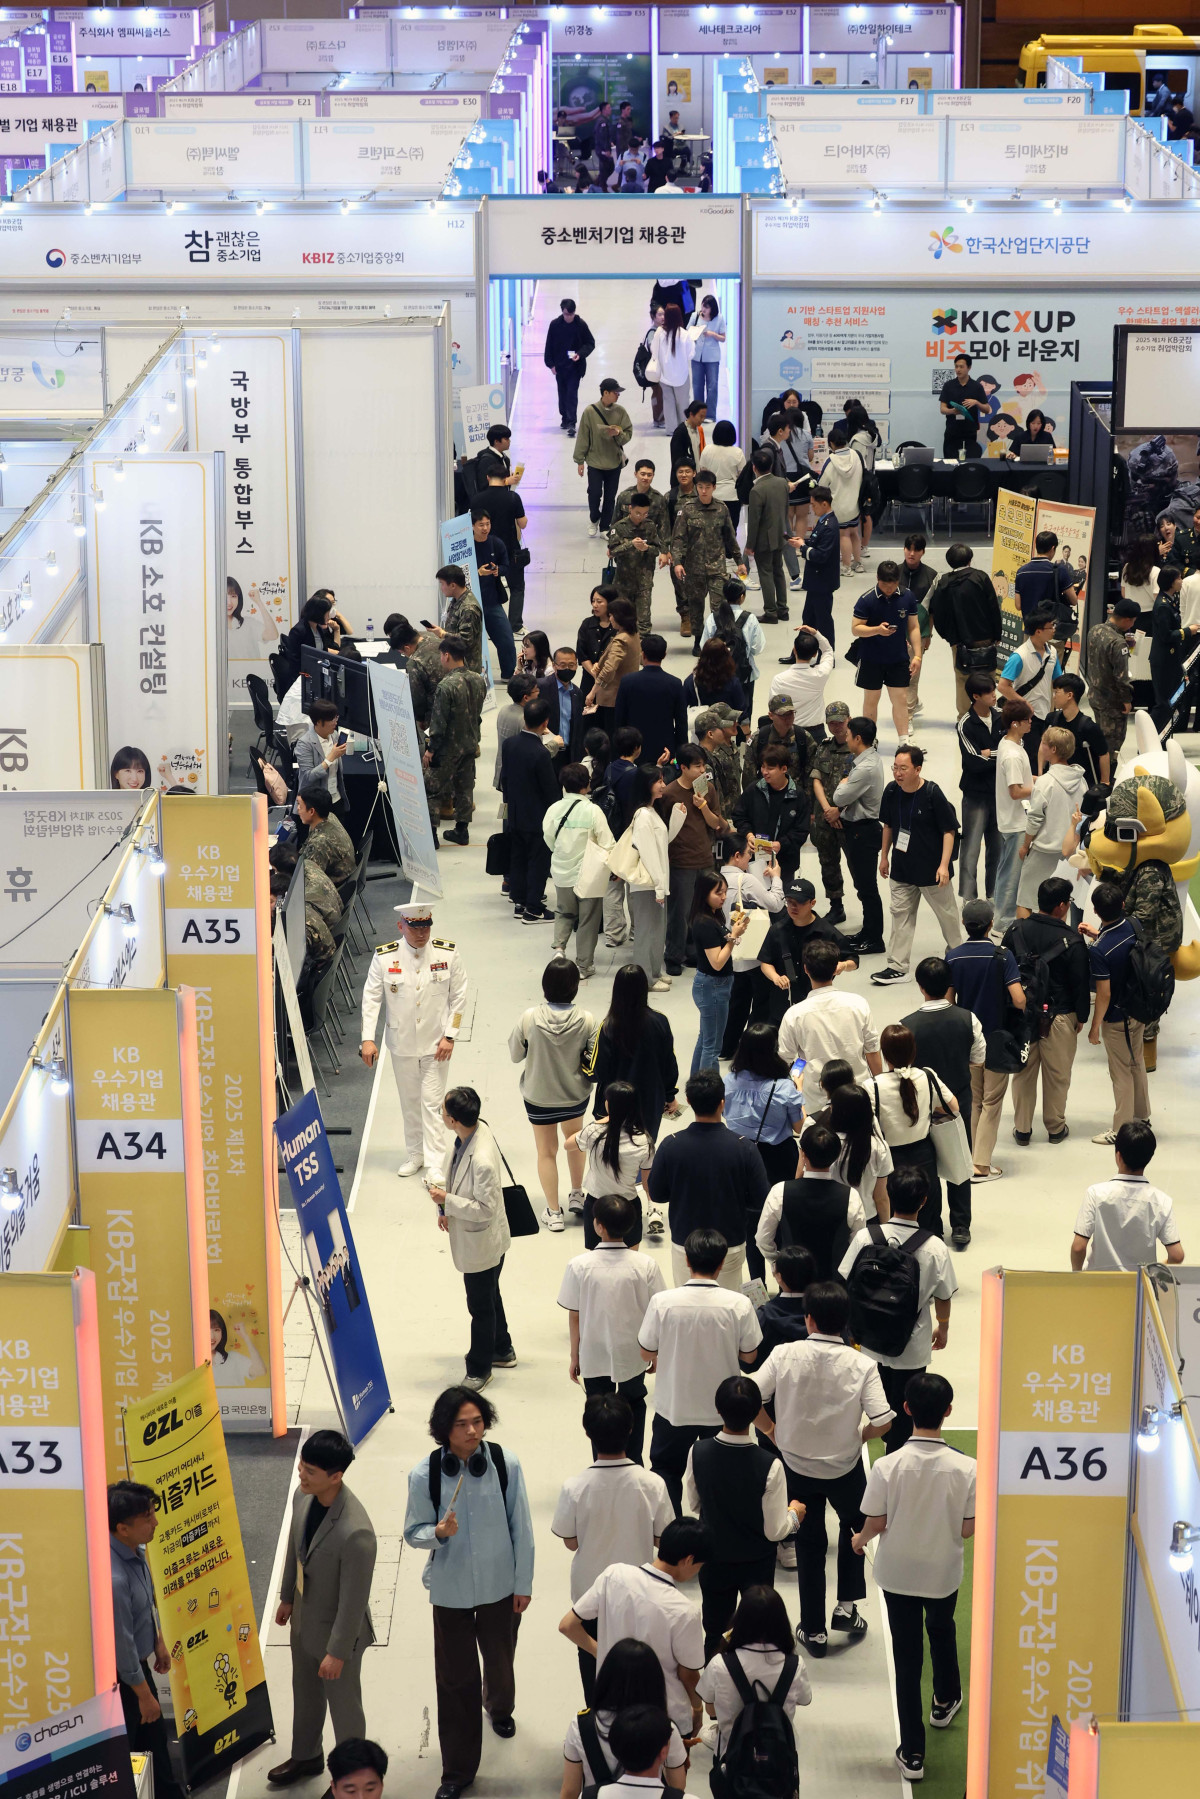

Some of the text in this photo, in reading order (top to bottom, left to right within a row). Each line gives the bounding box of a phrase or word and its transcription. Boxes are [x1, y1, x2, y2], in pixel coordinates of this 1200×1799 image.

[79, 27, 171, 38] 주식회사 엠피씨플러스
[698, 24, 761, 35] 세나테크코리아
[27, 69, 42, 77] E17
[1, 84, 17, 92] E18
[297, 98, 311, 106] E21
[463, 98, 476, 106] E30
[1067, 96, 1081, 104] F20
[15, 118, 38, 132] 기업
[42, 118, 78, 132] 채용관
[448, 220, 465, 229] H12
[541, 226, 687, 246] 중소벤처기업 채용관
[966, 237, 1090, 254] 한국산업단지공단
[184, 230, 260, 263] 참 괜찮은
[216, 249, 261, 262] 중소기업
[70, 253, 142, 265] 중소벤처기업부
[337, 252, 404, 264] 중소기업중앙회
[800, 306, 816, 316] 기반
[818, 306, 851, 315] 스타트업
[853, 306, 885, 316] 지원사업
[1118, 307, 1134, 315] 우수
[845, 318, 868, 327] 서비스
[961, 310, 1076, 333] KICXUP
[1157, 344, 1192, 352] 취업박람회
[1167, 336, 1192, 344] KB굿잡
[926, 339, 1080, 362] 비즈모아 라운지
[230, 371, 251, 444] 국방부
[468, 422, 490, 433] 중소기업
[232, 458, 255, 554] 통합부스
[140, 519, 168, 695] KB 소호 컨설팅
[0, 728, 29, 772] KB
[197, 846, 220, 859] KB
[179, 865, 240, 882] 우수기업
[187, 885, 233, 902] 채용관
[182, 919, 241, 944] A35
[113, 1046, 140, 1063] KB
[92, 1069, 163, 1089] 우수기업
[101, 1093, 156, 1113] 채용관
[224, 1074, 246, 1176] 2025 제1차
[96, 1132, 167, 1160] A34
[280, 1119, 321, 1162] Human
[294, 1151, 319, 1187] TSS
[105, 1209, 139, 1305] KB굿잡
[150, 1309, 172, 1364] 2025
[0, 1340, 30, 1360] KB
[113, 1307, 139, 1387] 우수기업
[1052, 1344, 1085, 1366] KB
[1022, 1372, 1111, 1396] 우수기업
[184, 1403, 202, 1421] 이즐
[219, 1406, 267, 1415] B 국민은행
[1032, 1400, 1100, 1424] 채용관
[1020, 1446, 1109, 1480] A36
[156, 1466, 180, 1484] 여기저기
[154, 1464, 217, 1516] 이즐카드
[159, 1500, 220, 1543] 교통카드 캐시비로부터
[163, 1539, 181, 1555] 지금의
[164, 1535, 224, 1576] 이즐크루는 새로운
[163, 1549, 232, 1595] 미래를 만들어갑니다.
[1019, 1539, 1059, 1653] KB굿잡
[44, 1651, 71, 1716] 2025
[1019, 1656, 1050, 1751] 우수기업
[34, 1714, 83, 1743] chosun
[47, 1775, 74, 1793] 생명으로
[75, 1764, 103, 1781] 연결하는
[70, 1770, 118, 1798] ICU 솔루션
